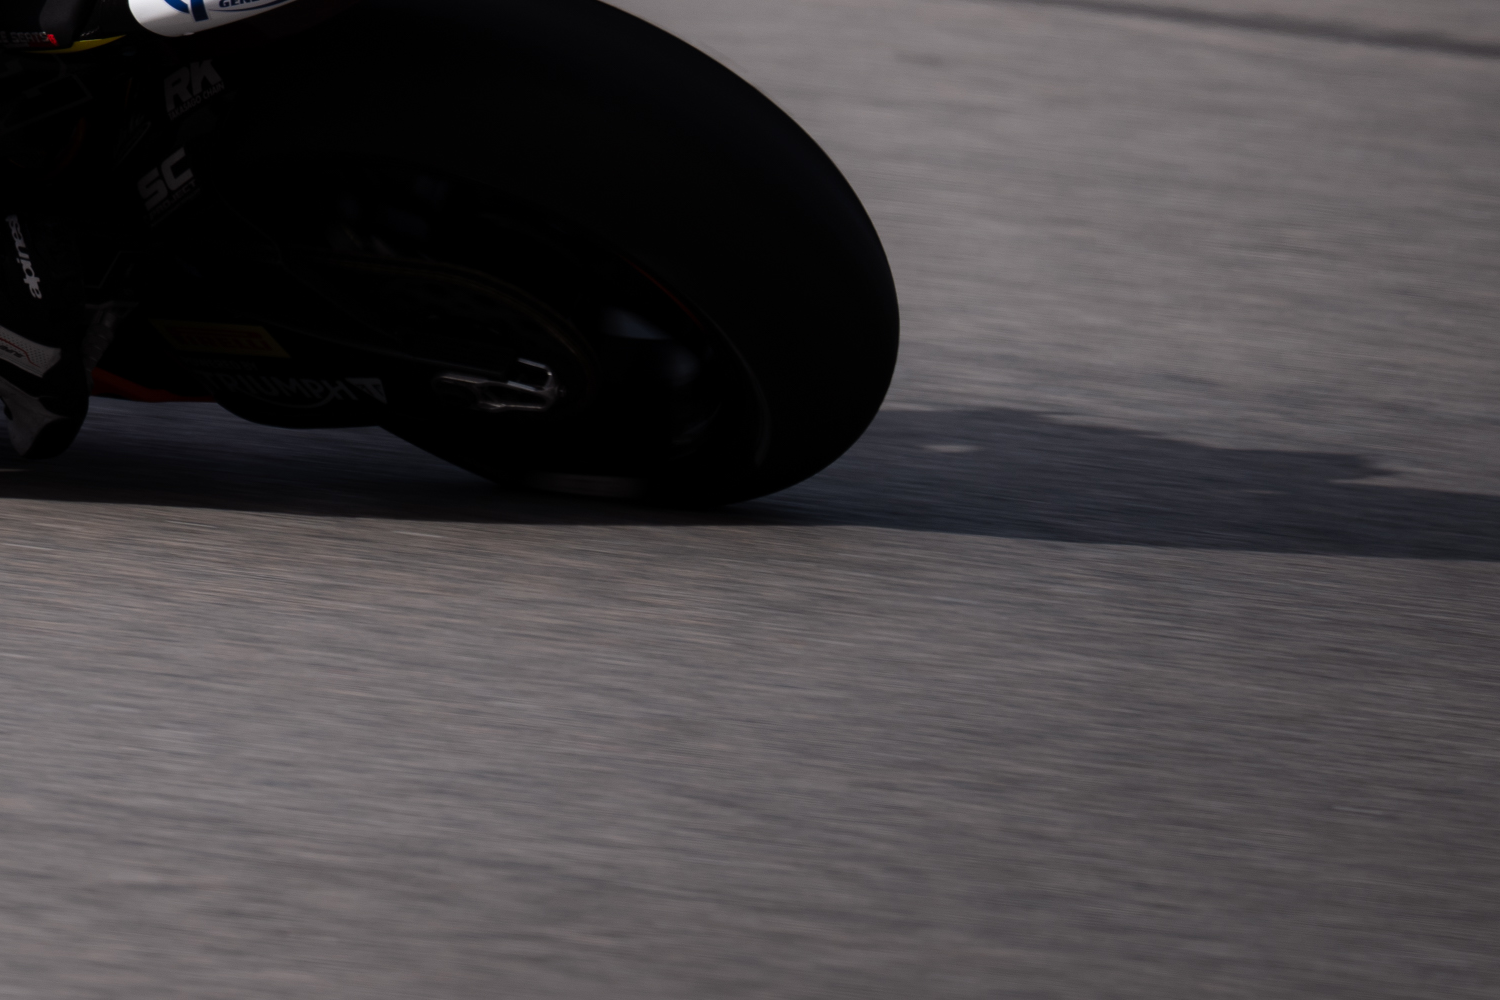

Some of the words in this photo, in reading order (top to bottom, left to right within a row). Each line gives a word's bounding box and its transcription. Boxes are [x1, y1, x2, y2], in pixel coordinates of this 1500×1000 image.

[163, 58, 225, 120] RK
[136, 147, 196, 211] SC
[4, 213, 43, 300] alpinest
